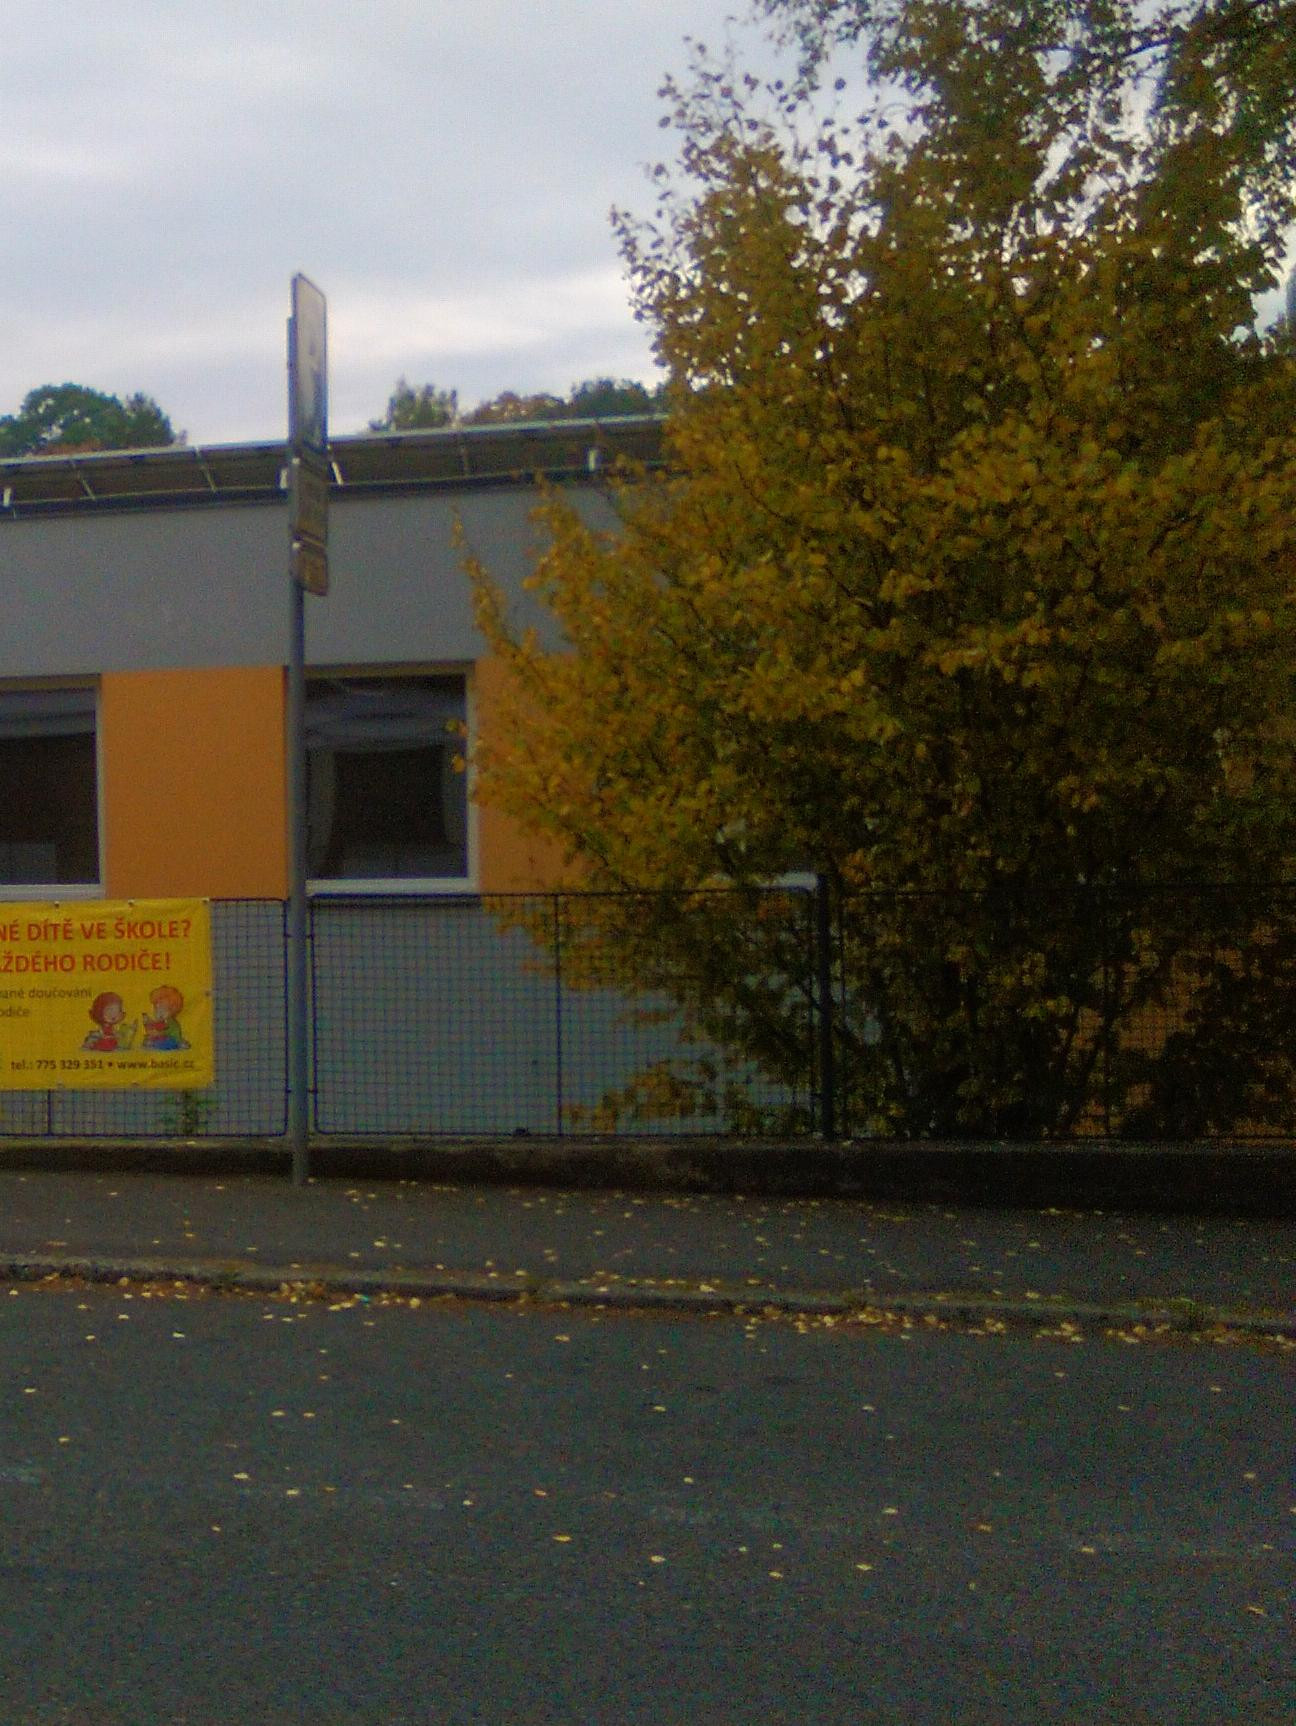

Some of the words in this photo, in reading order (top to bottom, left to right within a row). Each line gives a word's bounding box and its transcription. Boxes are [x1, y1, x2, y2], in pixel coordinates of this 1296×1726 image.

[27, 919, 73, 941] DÍTĚ
[80, 922, 106, 940] VE
[114, 917, 192, 940] ŠKOLE?
[83, 950, 171, 972] RODIČE!
